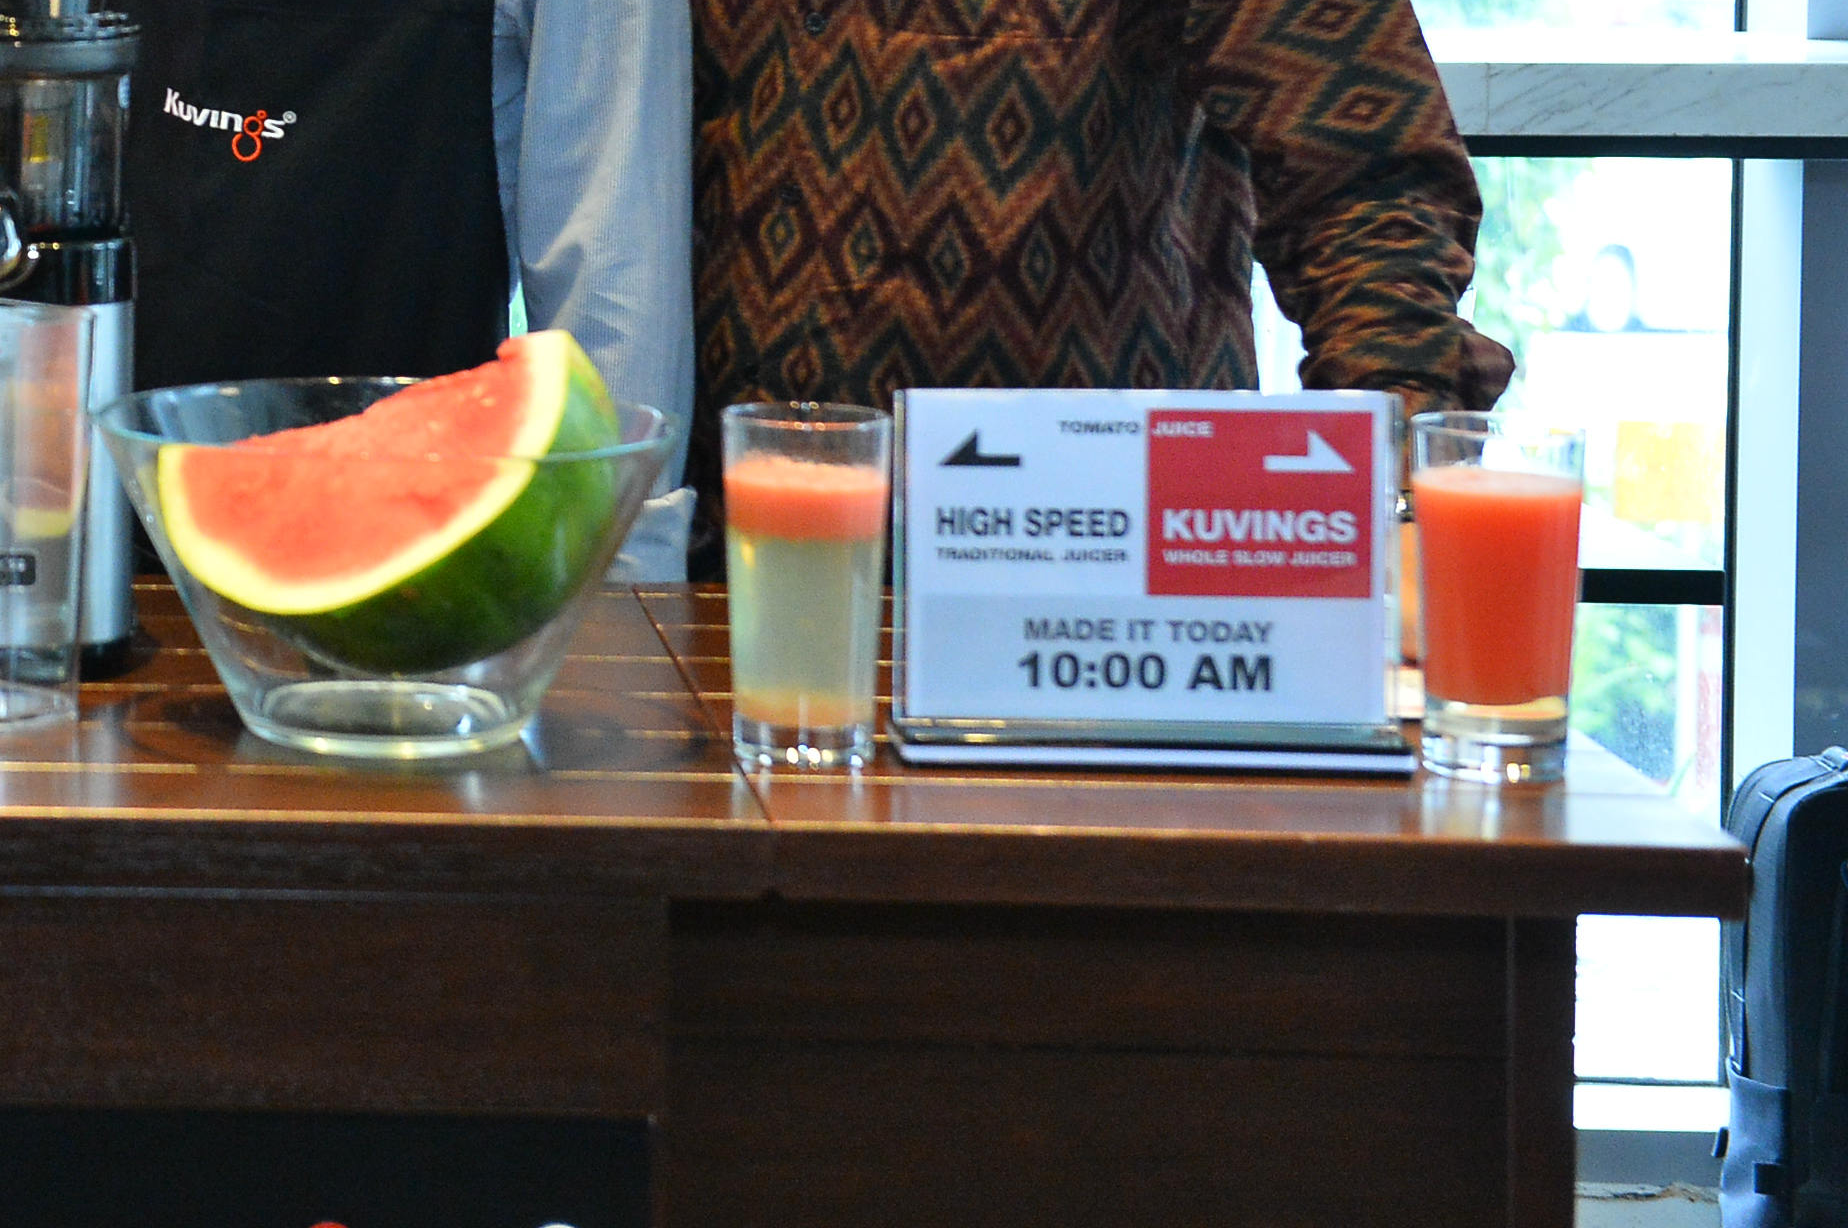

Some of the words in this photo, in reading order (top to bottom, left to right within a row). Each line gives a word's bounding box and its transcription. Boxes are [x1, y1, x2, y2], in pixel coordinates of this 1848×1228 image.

[1058, 420, 1140, 435] TOMATO
[1153, 421, 1214, 437] JUICE
[936, 508, 1013, 537] HIGH
[1024, 508, 1130, 537] SPEED
[1162, 508, 1358, 544] KUVINGS
[936, 547, 1054, 561] TRADITIONAL
[1063, 548, 1128, 562] JUICER
[1163, 549, 1230, 565] WHOLE
[1232, 550, 1285, 566] SLOW
[1290, 551, 1358, 567] JUICER
[1024, 618, 1115, 641] MADE
[1127, 619, 1155, 641] IT
[1166, 620, 1273, 643] TODAY
[1018, 650, 1167, 690] 10:00
[1187, 653, 1273, 692] AM
